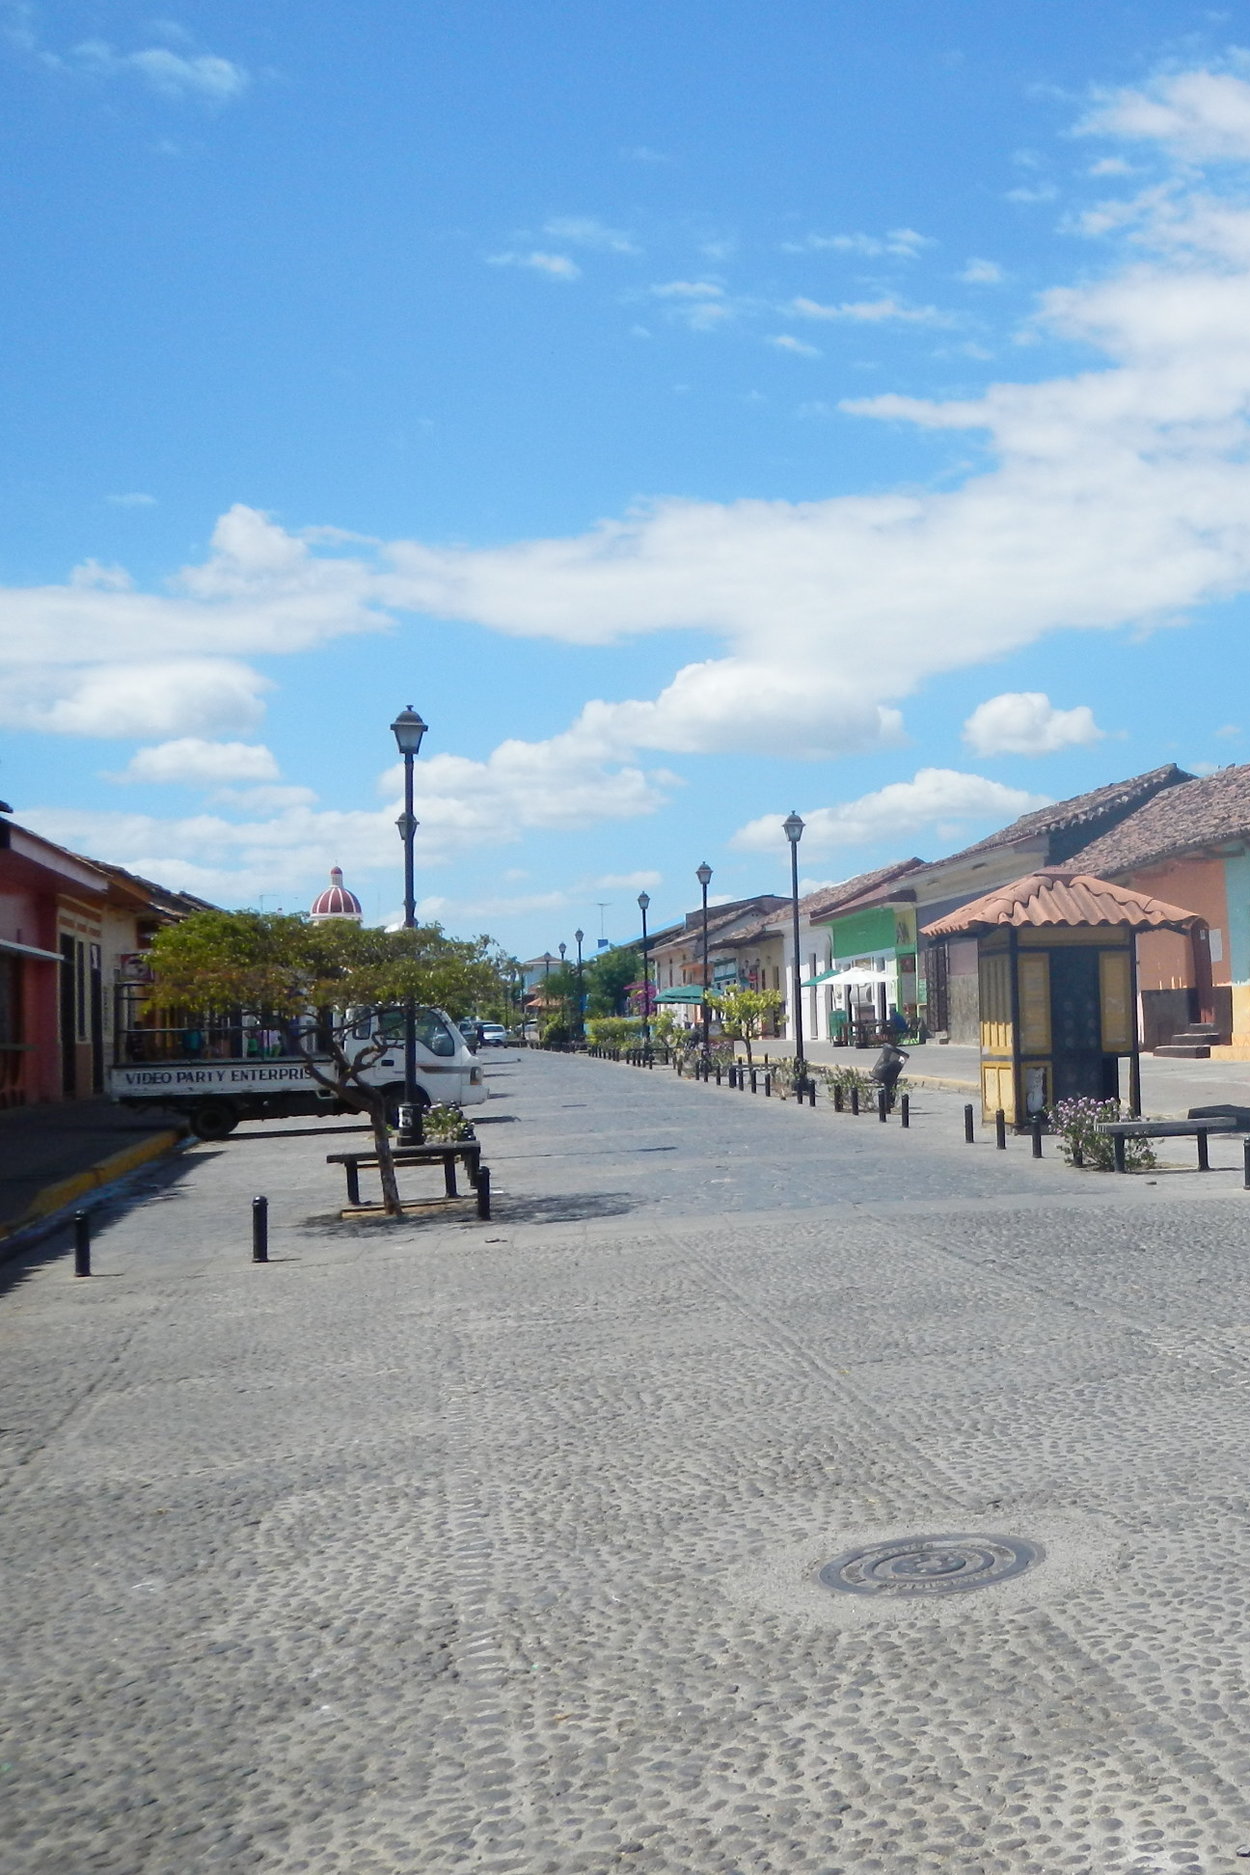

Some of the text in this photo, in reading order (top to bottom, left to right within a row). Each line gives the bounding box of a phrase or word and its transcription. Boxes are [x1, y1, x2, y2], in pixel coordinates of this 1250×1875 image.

[125, 1066, 320, 1085] VIDEO PARTY ENTERPRIS
